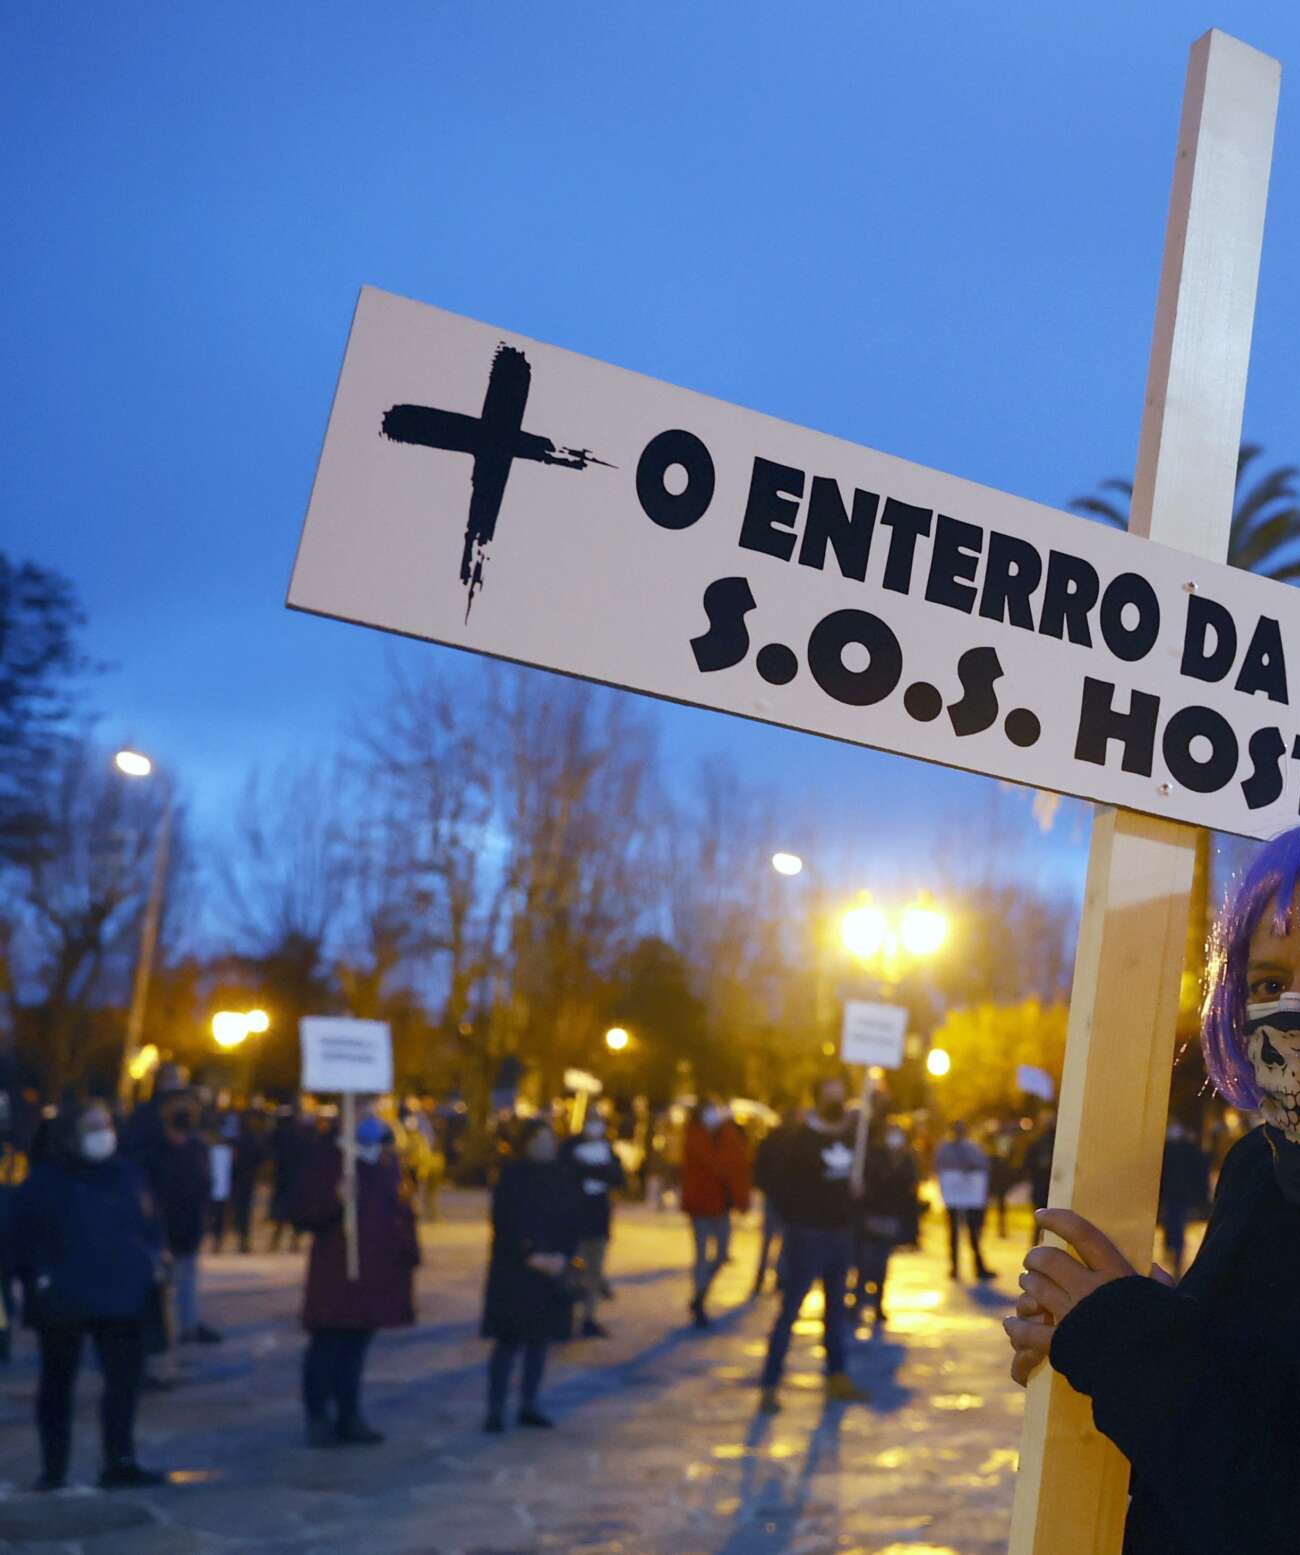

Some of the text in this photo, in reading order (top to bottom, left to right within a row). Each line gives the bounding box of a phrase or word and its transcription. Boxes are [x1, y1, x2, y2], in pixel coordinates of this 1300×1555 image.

[635, 429, 716, 530] O
[738, 455, 1161, 662] ENTERRO
[1180, 593, 1289, 706] DA
[689, 576, 1041, 749] S.O.S.
